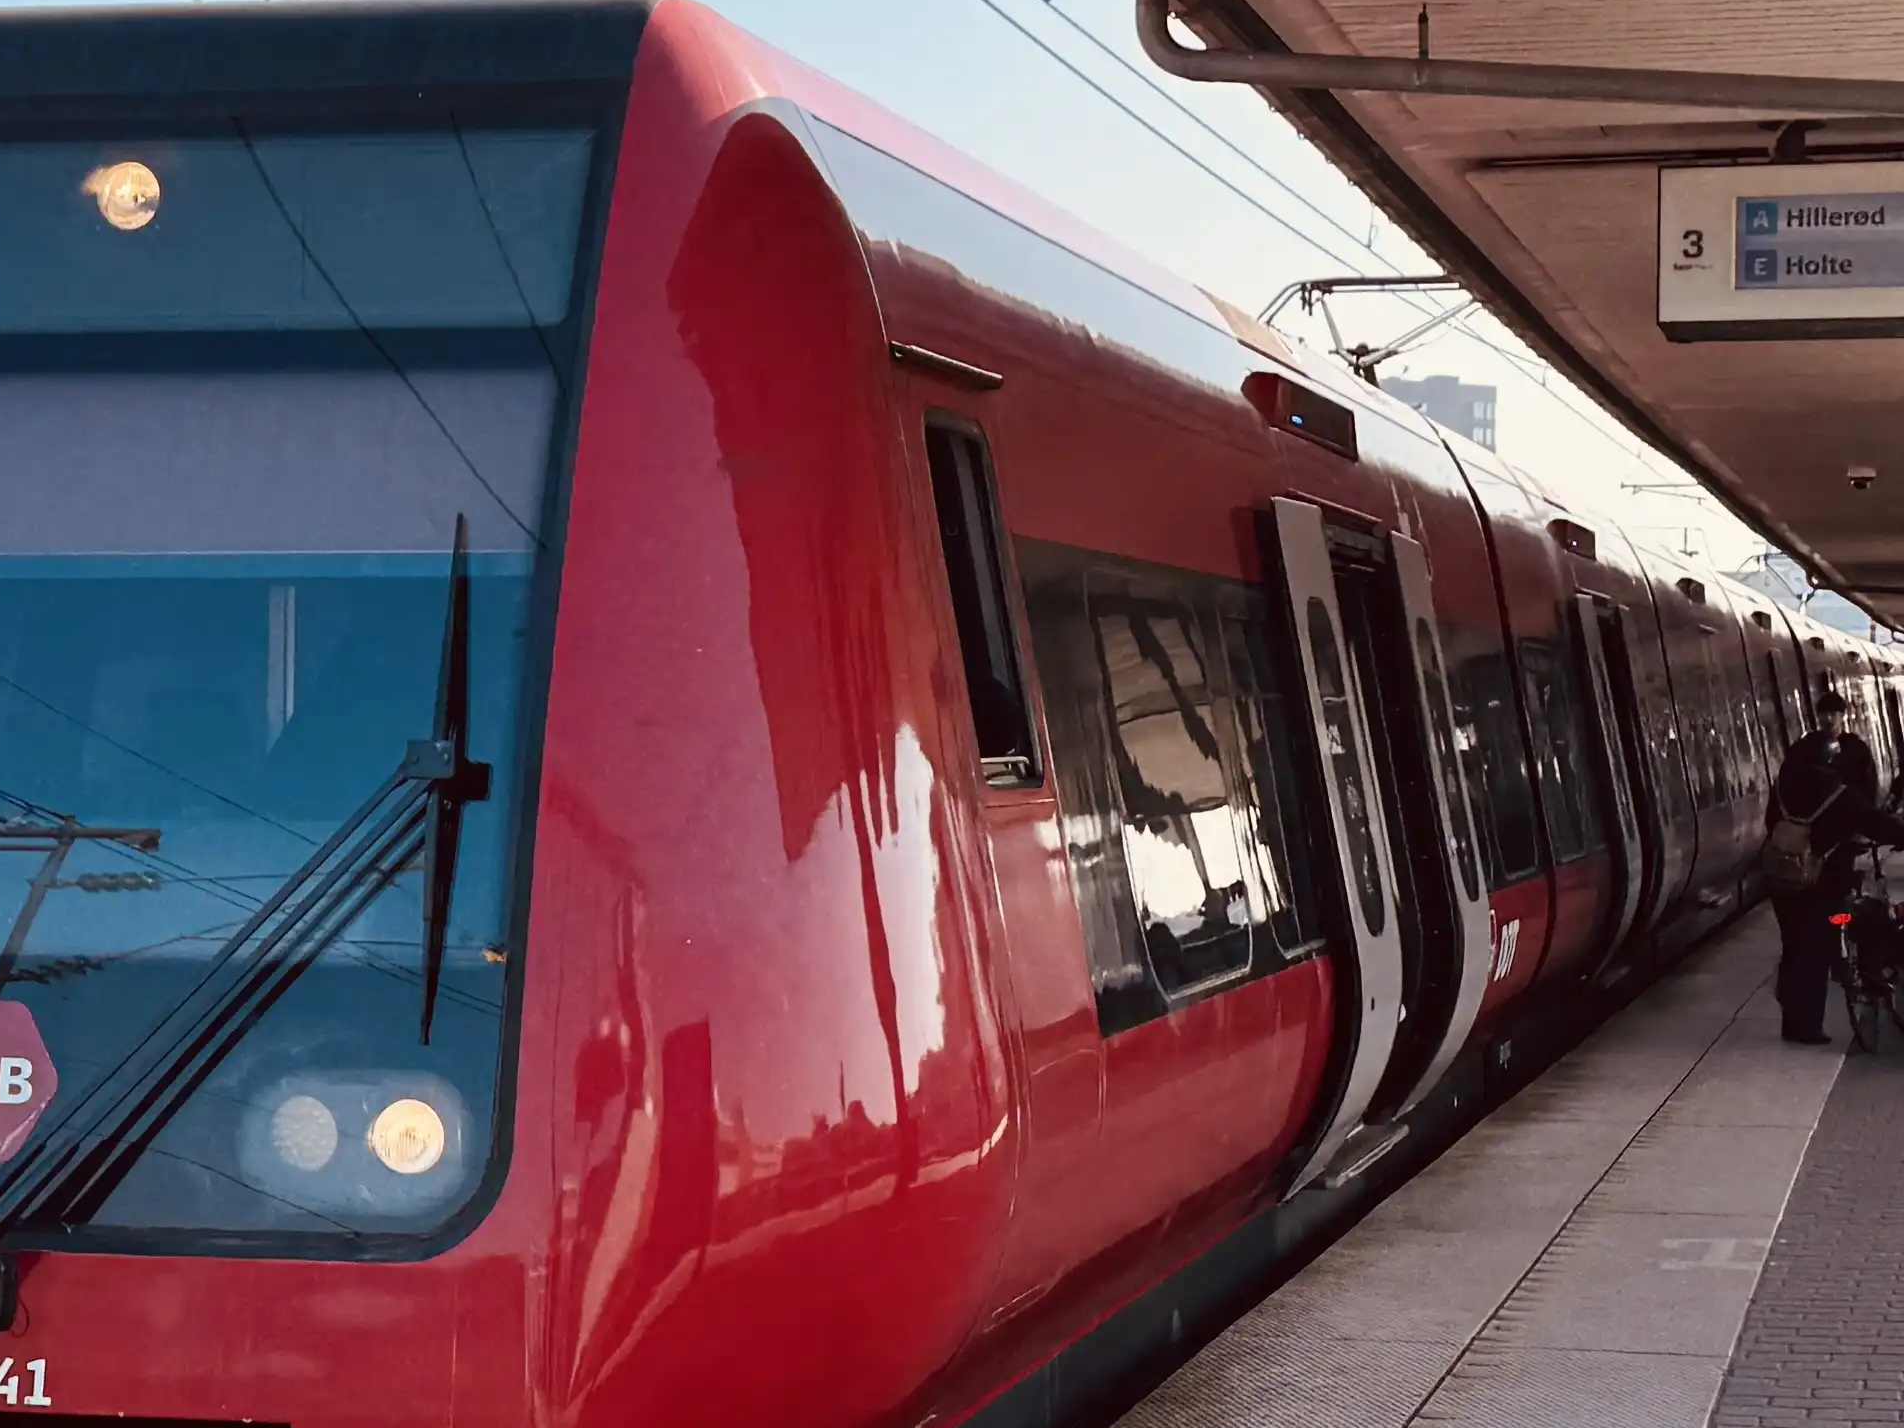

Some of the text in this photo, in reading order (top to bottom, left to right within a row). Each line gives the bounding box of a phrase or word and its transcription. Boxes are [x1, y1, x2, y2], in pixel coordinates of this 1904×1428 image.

[1753, 210, 1768, 228] A
[1785, 207, 1886, 229] Hillerød
[1682, 229, 1704, 259] 3
[1754, 257, 1768, 276] E
[1785, 256, 1854, 276] Holte
